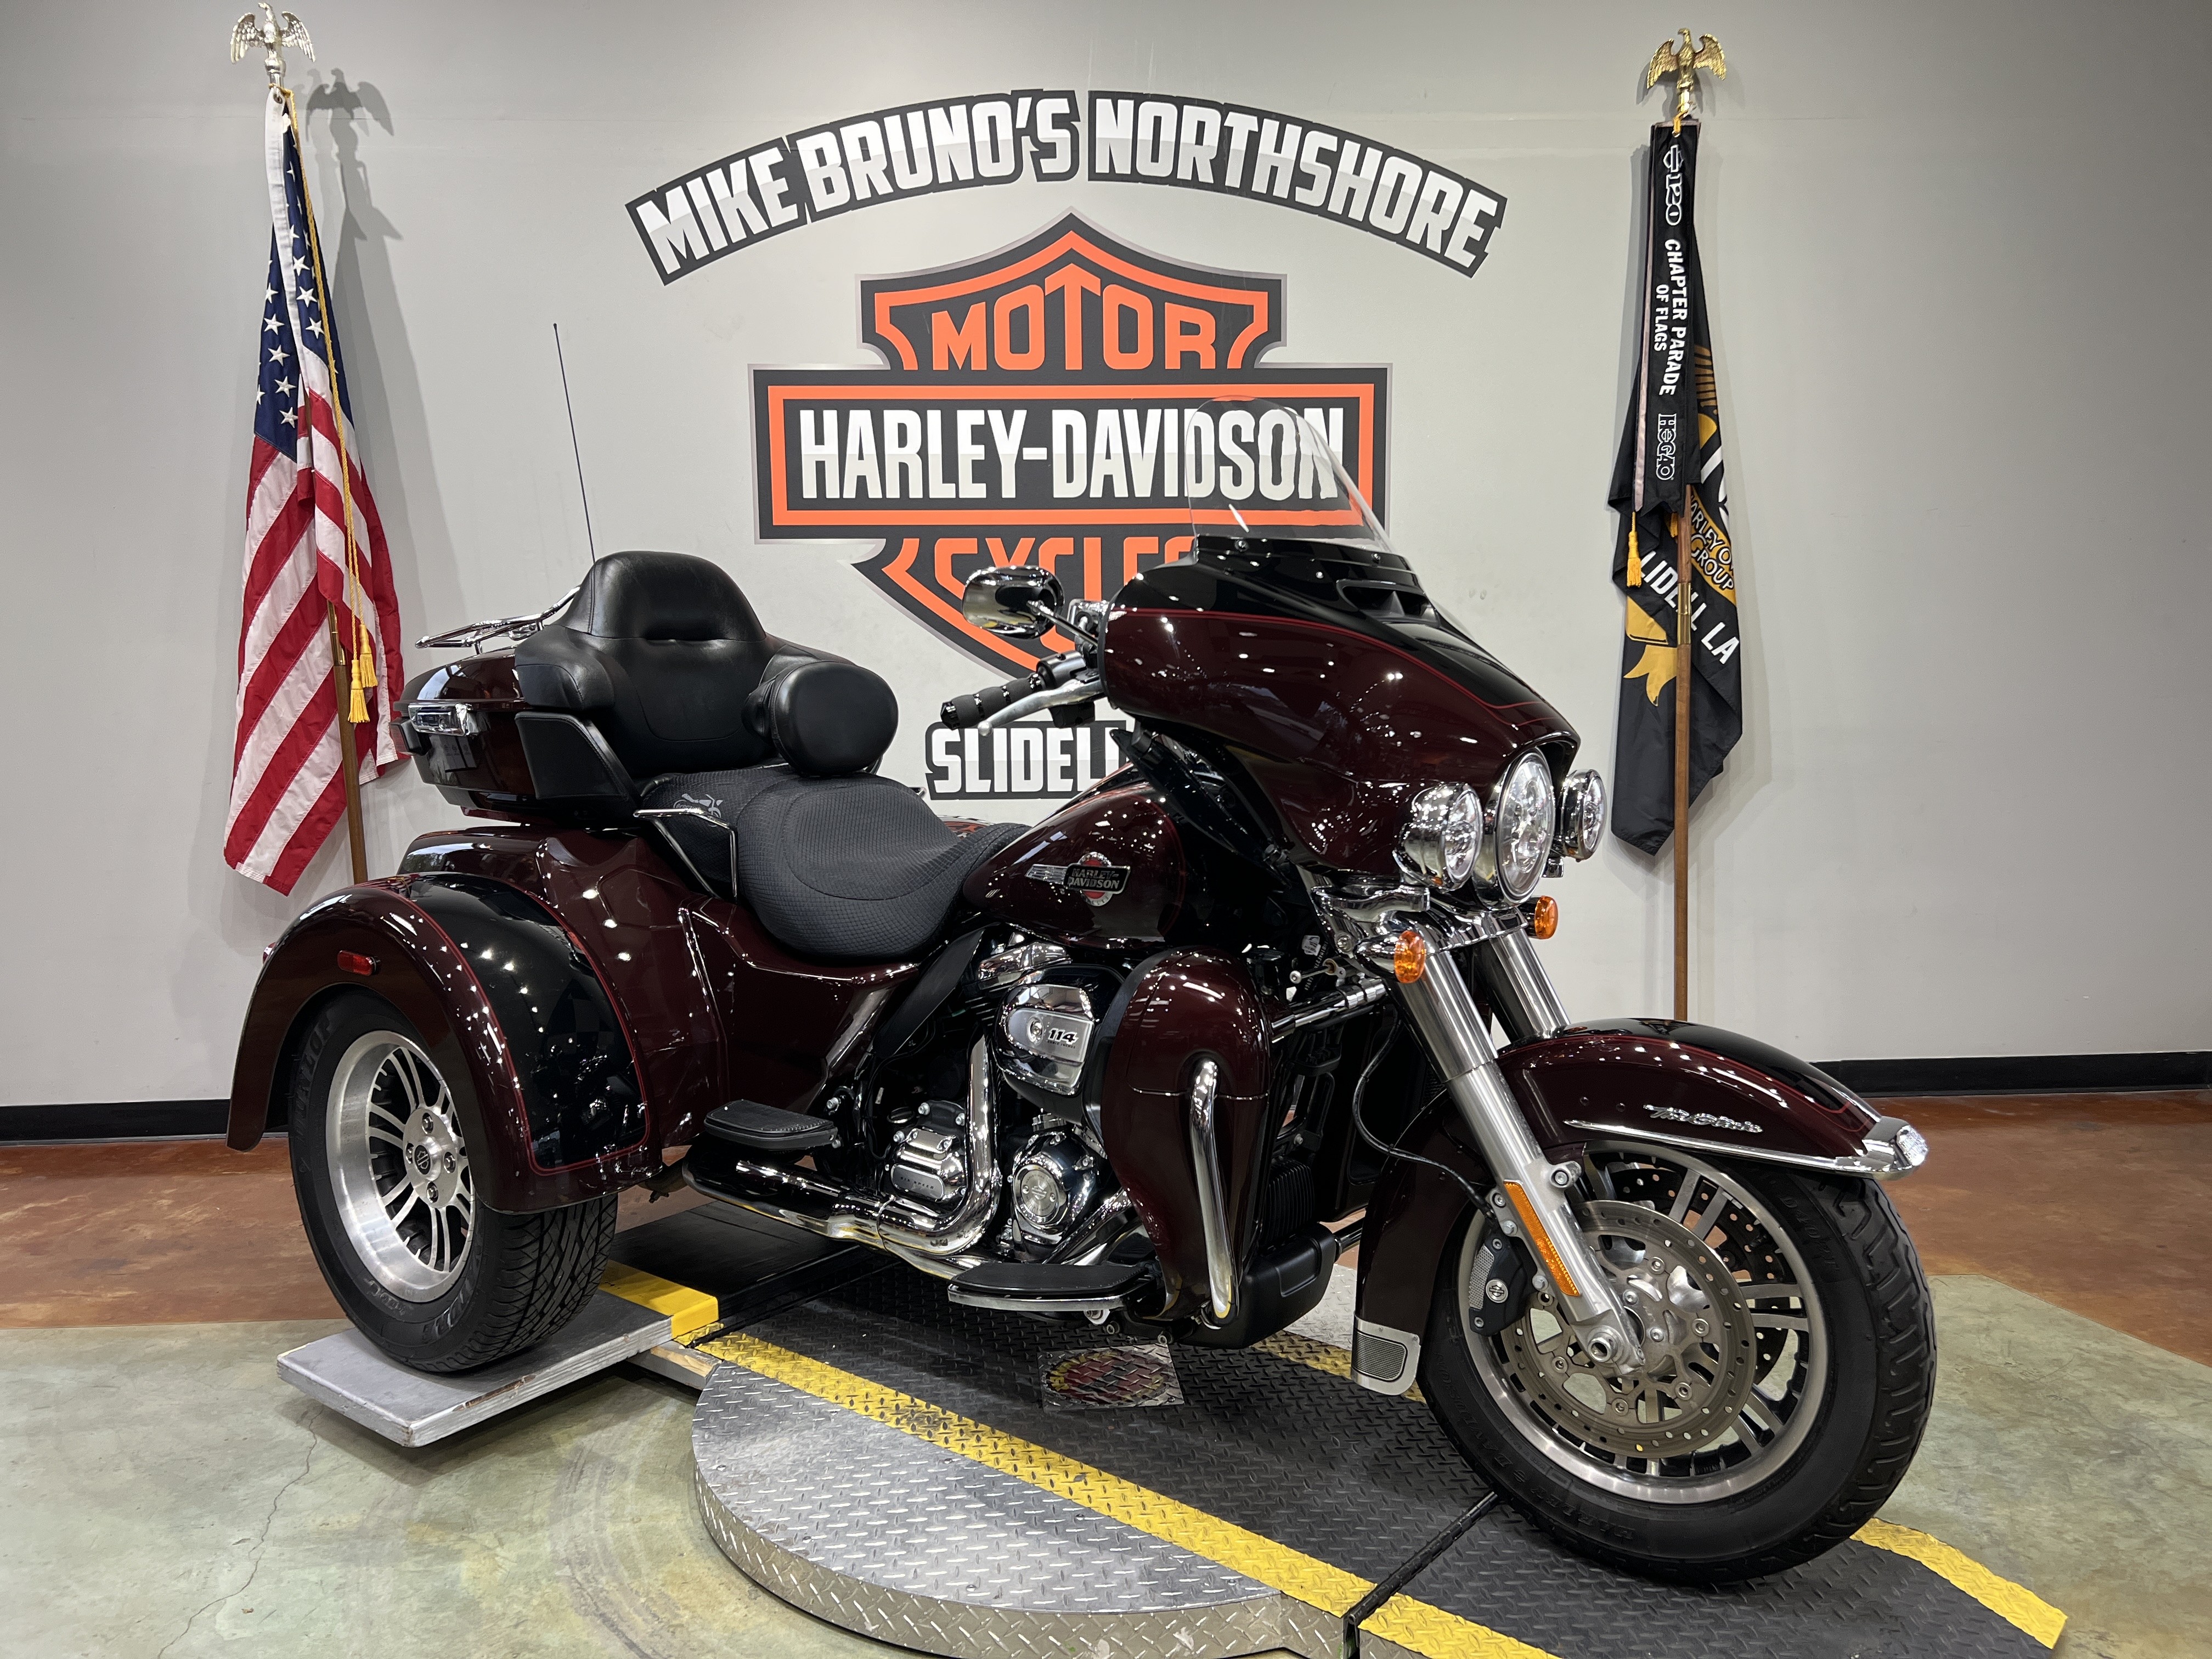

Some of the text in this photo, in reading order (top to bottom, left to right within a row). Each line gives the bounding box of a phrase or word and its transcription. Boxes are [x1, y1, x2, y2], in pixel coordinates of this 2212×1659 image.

[636, 97, 1499, 275] MIKE BRUNO'S NORTHSHORE
[1665, 172, 1682, 226] 120
[931, 263, 1216, 370] MOTOR
[1653, 284, 1669, 352] OF FLAGS
[1658, 238, 1688, 396] CHAPTER PARADE
[799, 407, 1345, 501] HARLEY-DAVIDSON
[1691, 532, 1734, 590] GROUP
[1701, 622, 1740, 665] LA
[1068, 876, 1120, 889] DAVIDSON
[1071, 868, 1119, 878] HARLEY-
[1048, 1028, 1079, 1045] 114
